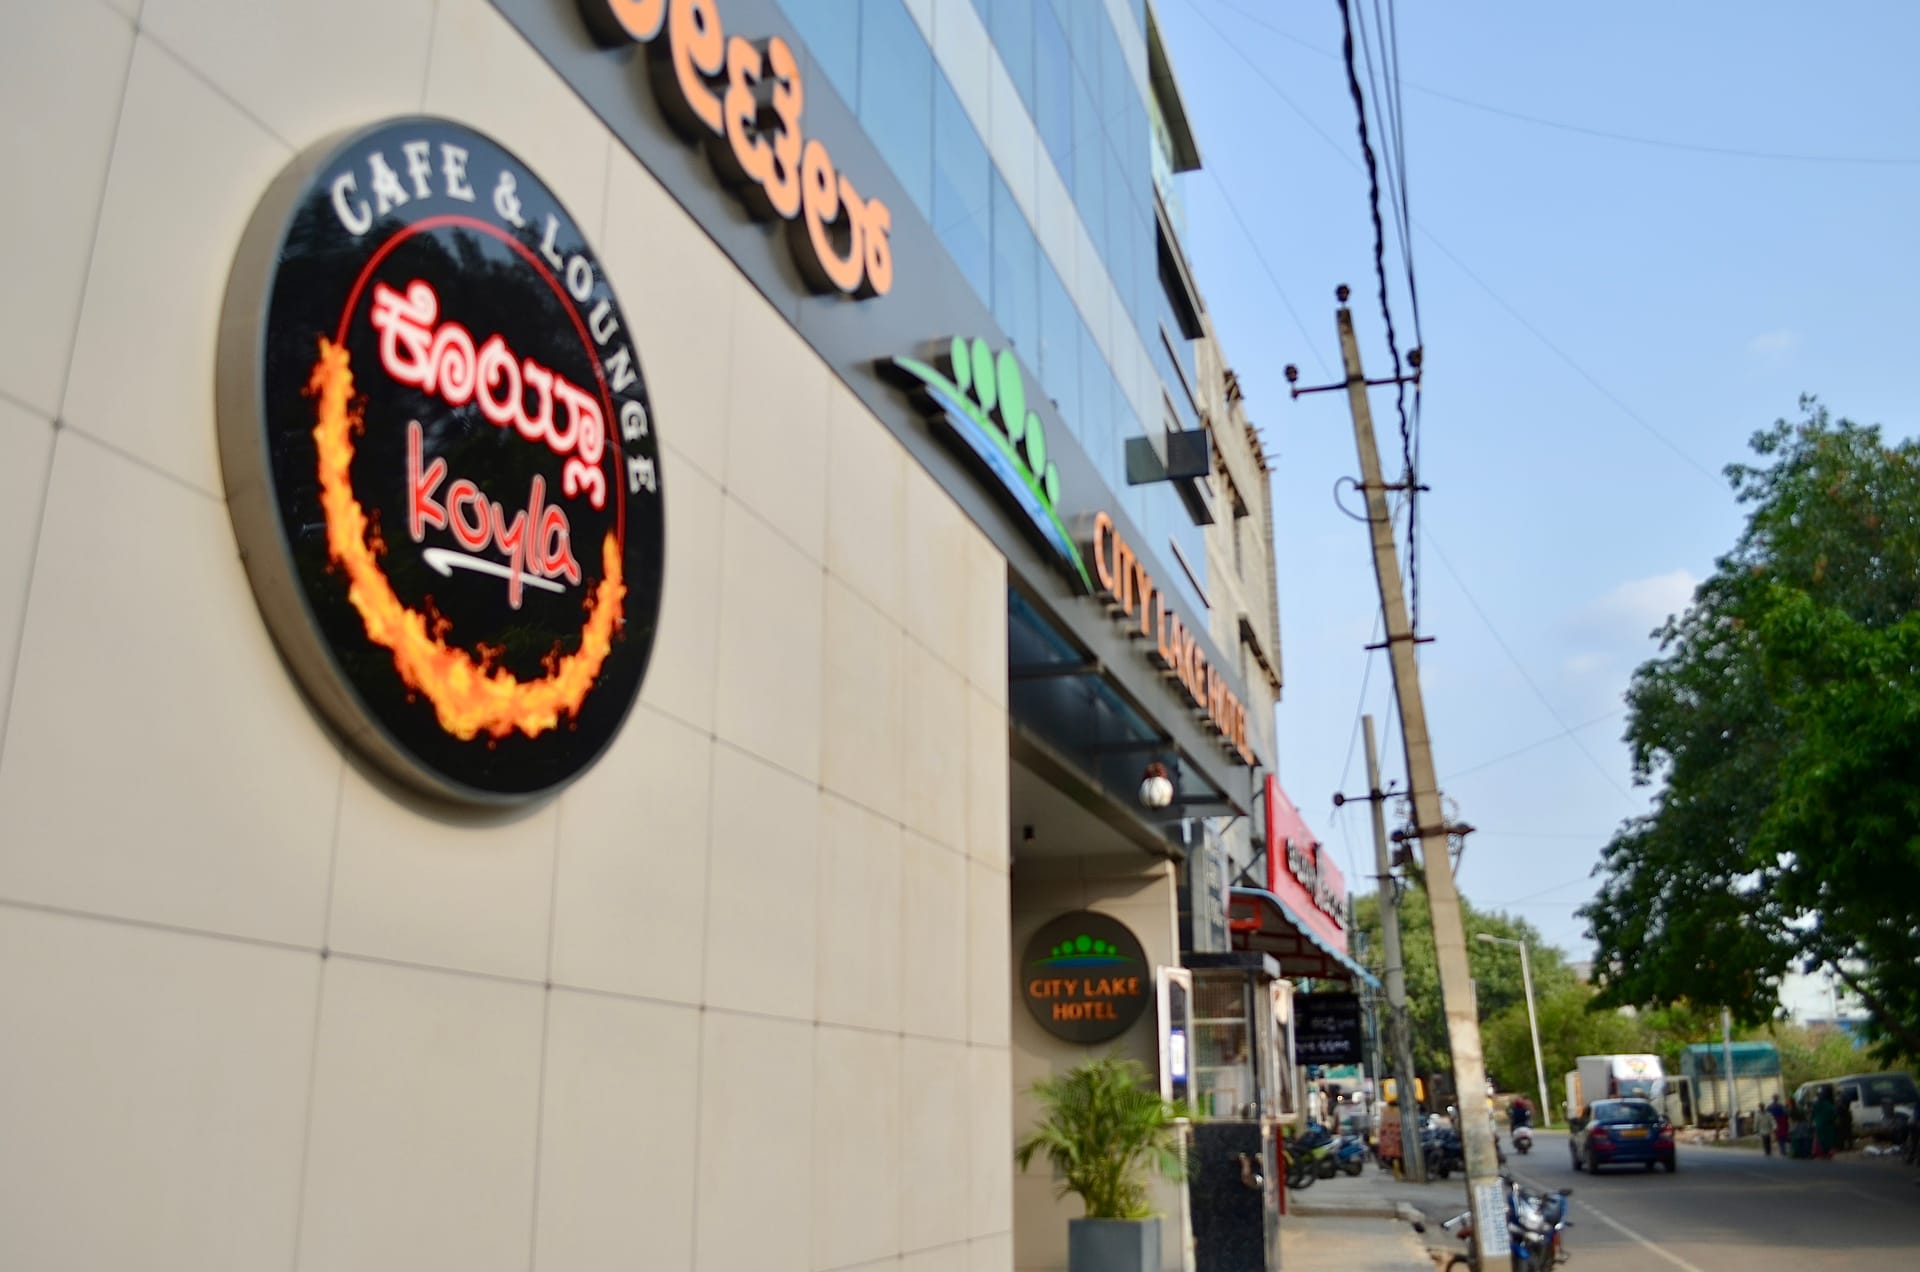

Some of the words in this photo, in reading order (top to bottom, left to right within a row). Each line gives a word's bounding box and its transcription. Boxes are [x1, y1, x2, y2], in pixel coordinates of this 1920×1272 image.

[331, 140, 476, 236] CAFE
[493, 170, 526, 228] &
[540, 213, 658, 494] LOUNGE
[1093, 511, 1153, 637] CITY
[1156, 589, 1207, 708] LAKE
[1029, 977, 1079, 998] CITY
[1083, 975, 1141, 997] LAKE
[1052, 1001, 1118, 1020] HOTEL
